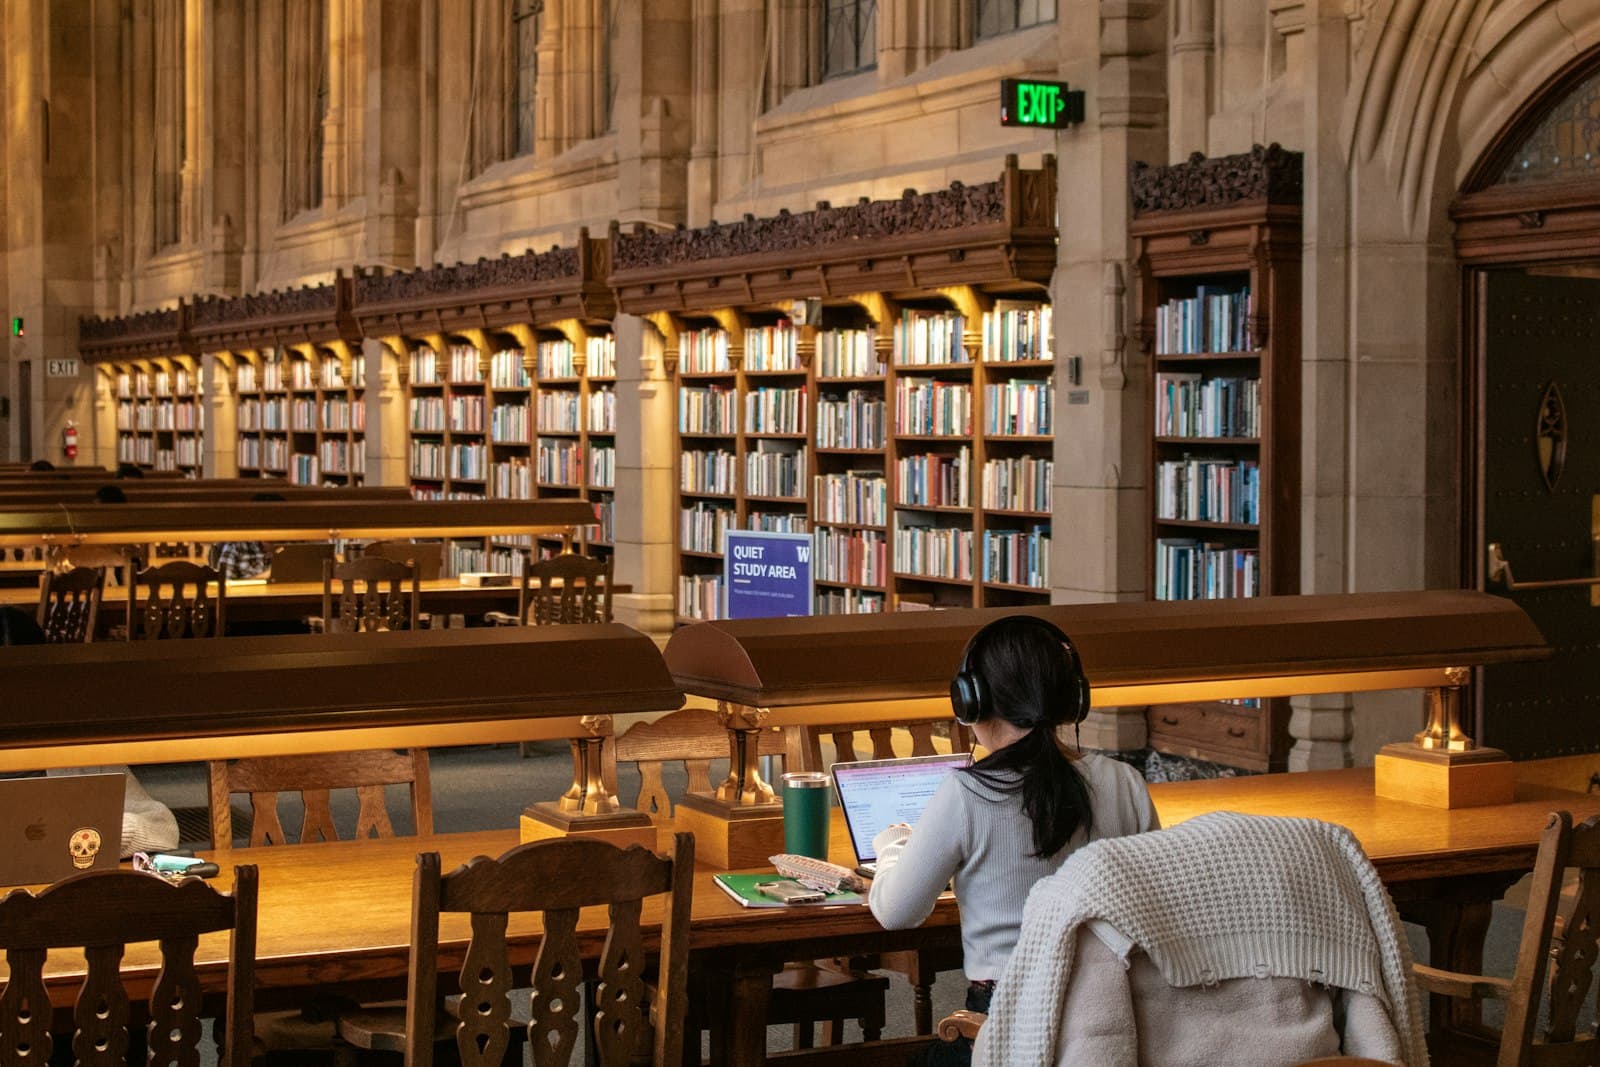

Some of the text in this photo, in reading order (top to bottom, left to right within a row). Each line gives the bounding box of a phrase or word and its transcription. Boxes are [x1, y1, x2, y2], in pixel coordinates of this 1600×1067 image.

[1018, 84, 1060, 124] EXIT
[49, 361, 76, 375] EXIT
[733, 545, 764, 559] QUIET
[796, 545, 809, 563] W
[733, 562, 797, 579] STUDY AREA
